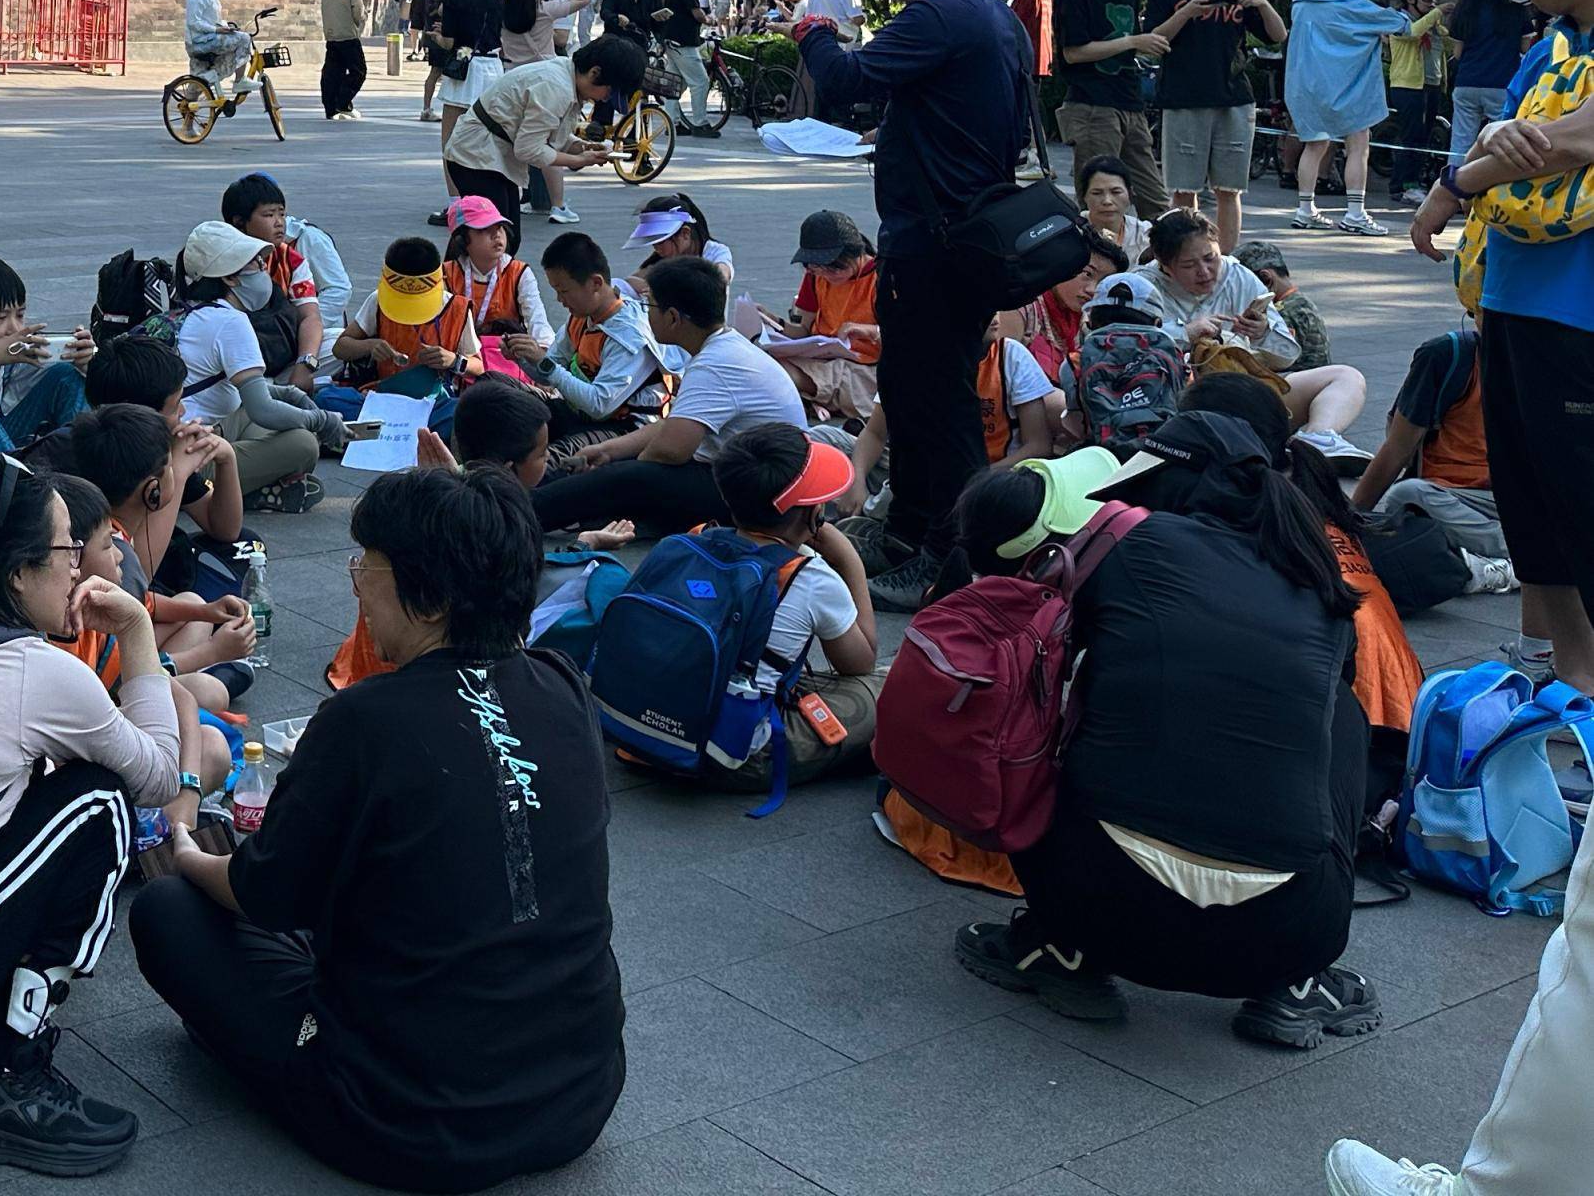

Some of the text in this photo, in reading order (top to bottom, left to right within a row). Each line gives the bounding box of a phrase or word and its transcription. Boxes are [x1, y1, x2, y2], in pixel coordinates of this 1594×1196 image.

[641, 714, 686, 738] SCHOLAR
[646, 709, 682, 728] STUDENT
[296, 1013, 313, 1046] adidas
